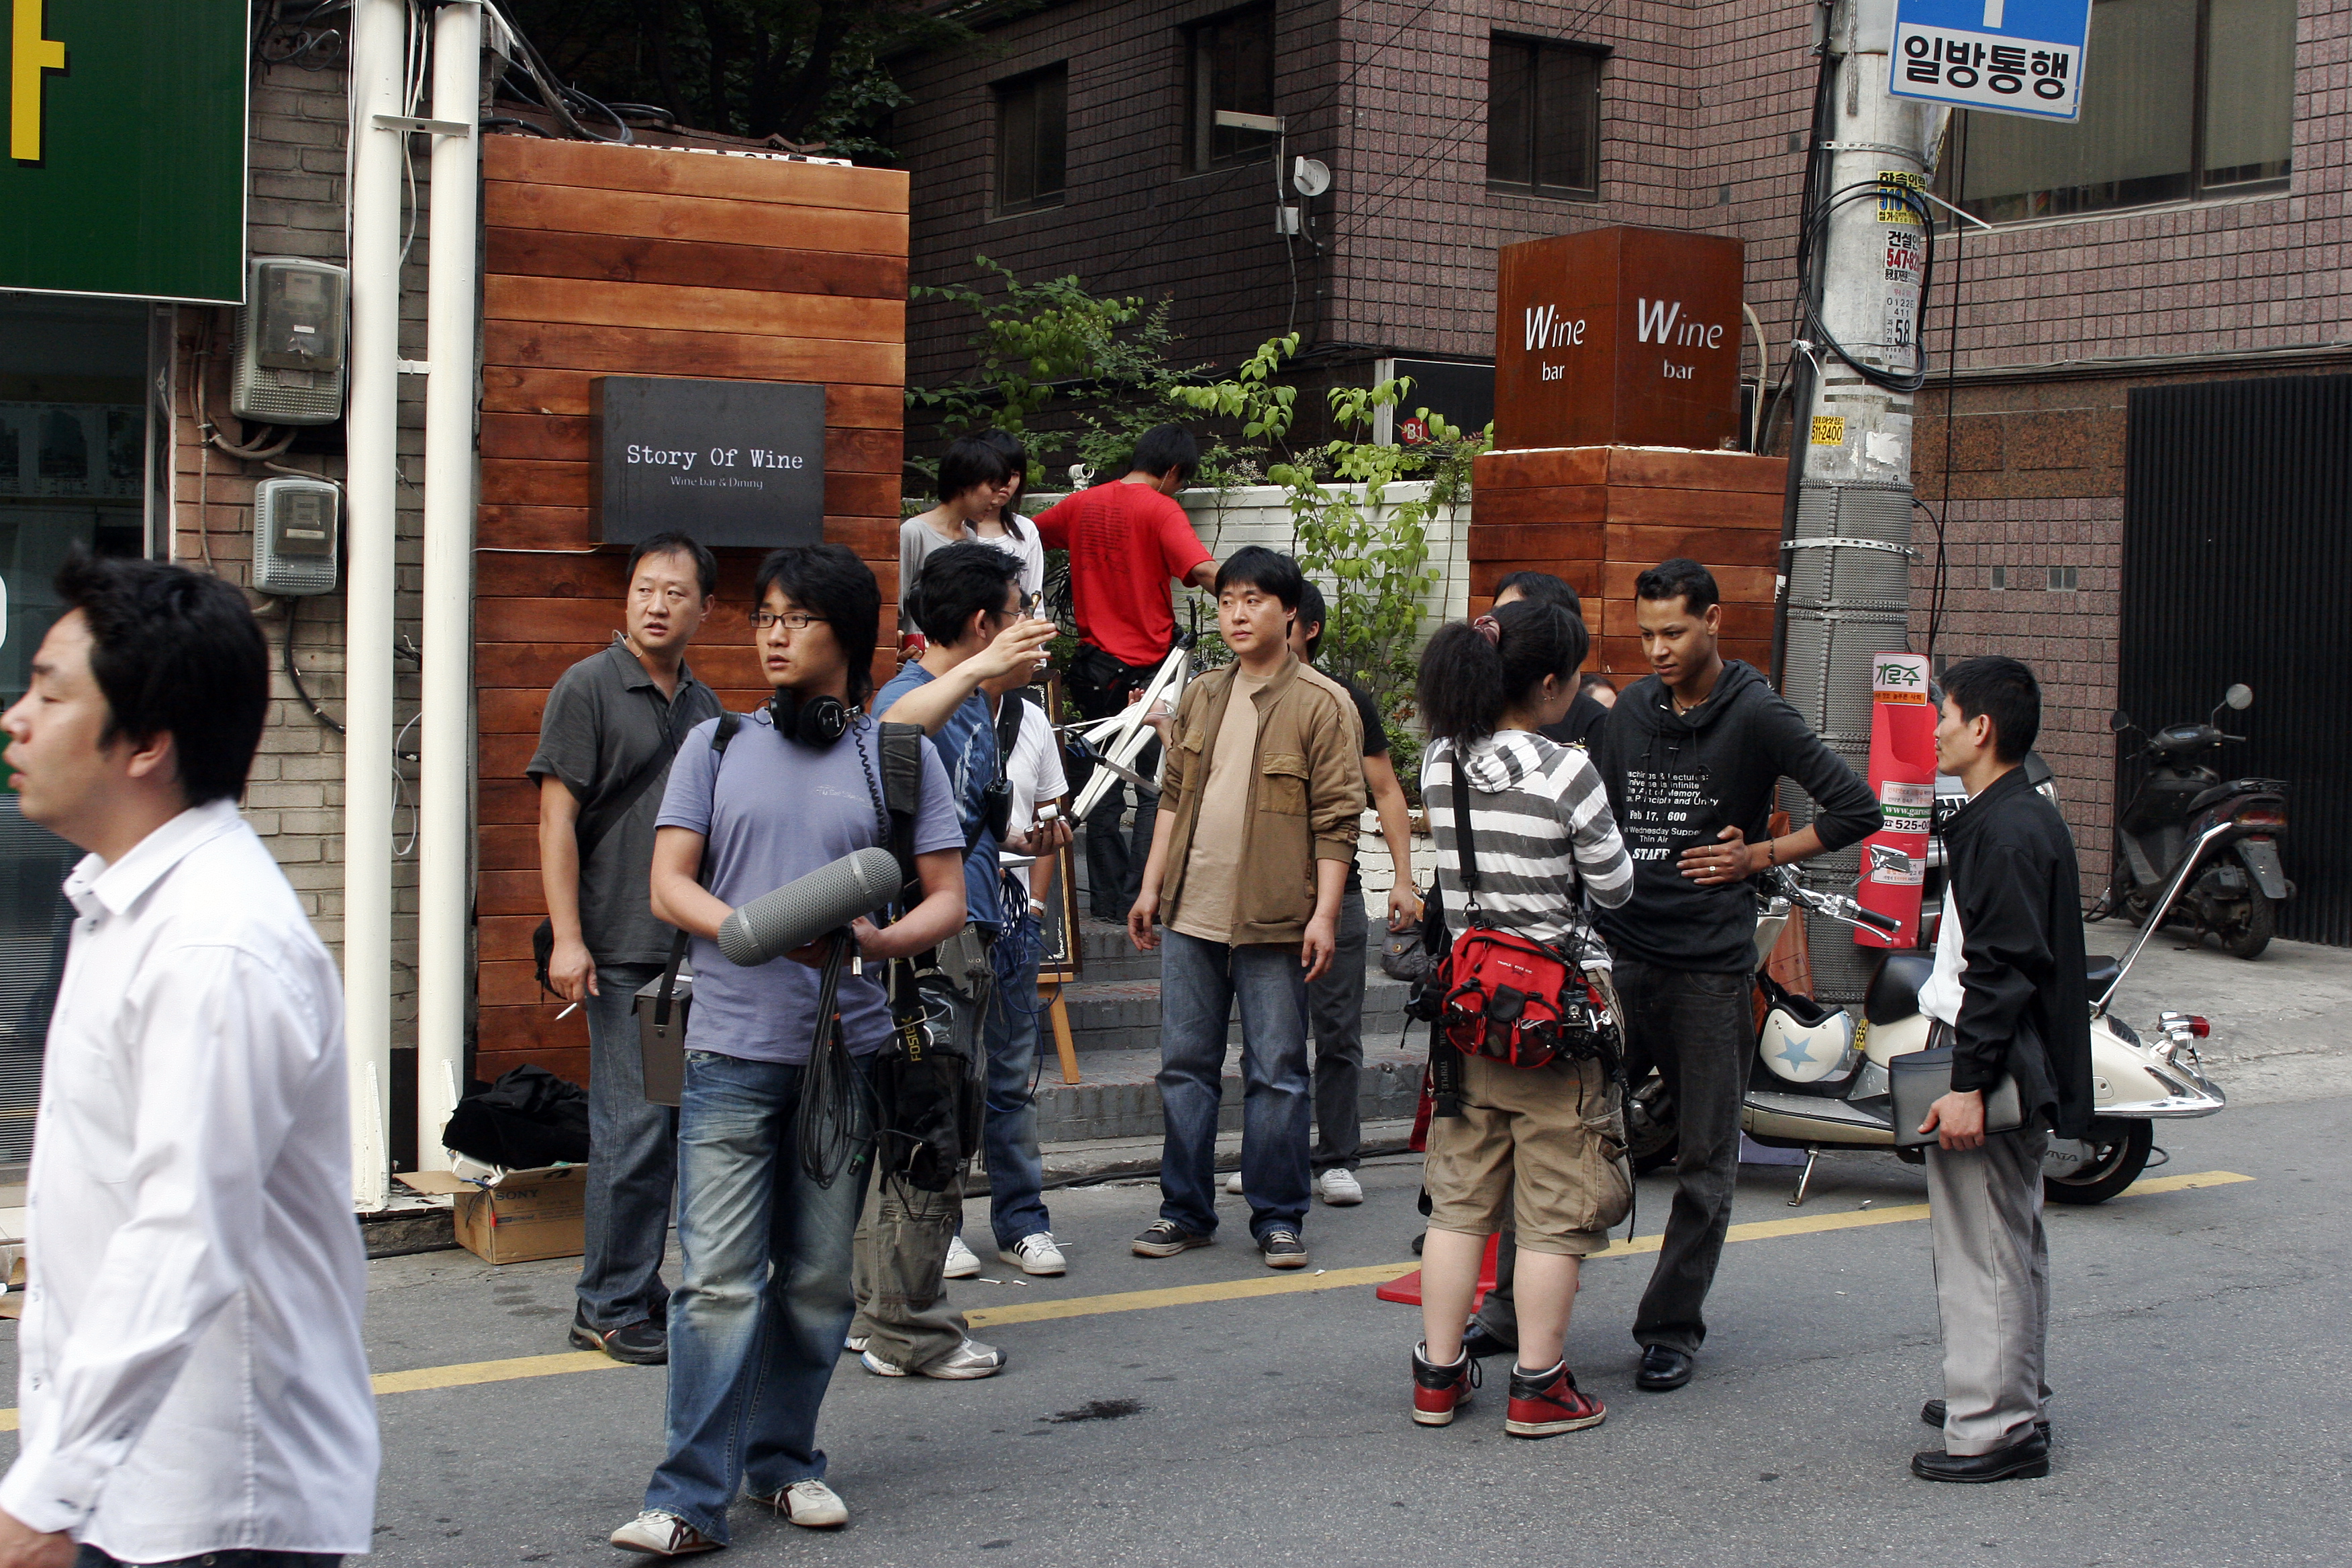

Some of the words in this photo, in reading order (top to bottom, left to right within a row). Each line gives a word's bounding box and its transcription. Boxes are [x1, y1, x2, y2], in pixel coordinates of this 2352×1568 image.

[1904, 36, 2069, 99] 일방통행
[1894, 308, 1909, 317] 411
[1525, 304, 1586, 351] Wine
[1638, 297, 1723, 349] Wine
[1895, 319, 1910, 345] 58
[1542, 361, 1565, 381] bar
[1663, 358, 1695, 380] bar
[1408, 423, 1422, 440] B1
[1812, 425, 1842, 441] 511-2400
[627, 444, 697, 471] Story
[710, 448, 738, 467] Of
[750, 449, 803, 469] Wine
[671, 476, 697, 486] Wine
[699, 477, 716, 487] bar
[729, 477, 763, 490] Dining
[1875, 663, 1921, 686] 가로수
[1630, 810, 1642, 820] Feb
[1645, 810, 1659, 822] 17,
[1629, 826, 1669, 836] Wednesday
[1640, 835, 1655, 843] Thin
[1632, 848, 1670, 861] STAFF
[495, 1189, 538, 1201] SONY
